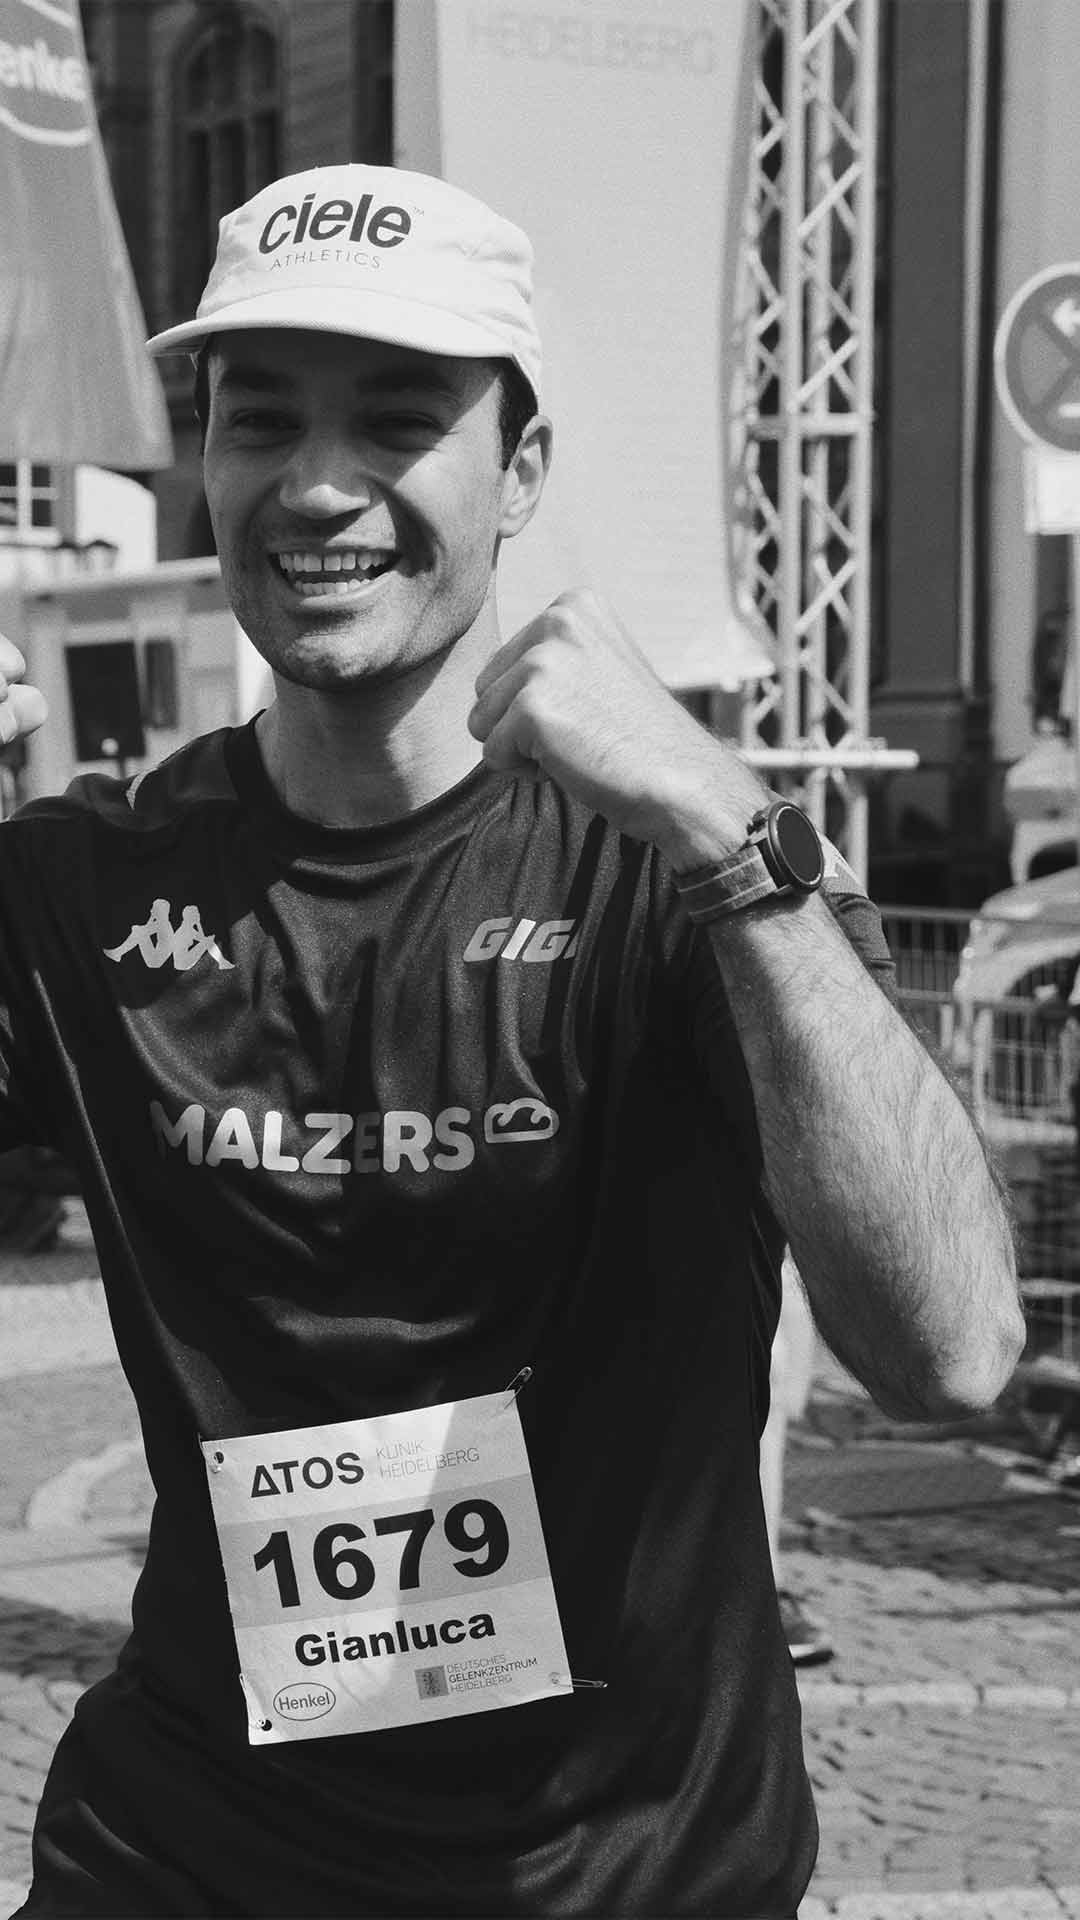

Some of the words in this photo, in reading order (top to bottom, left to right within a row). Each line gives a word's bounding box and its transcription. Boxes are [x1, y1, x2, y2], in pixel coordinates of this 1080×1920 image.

[259, 193, 412, 254] ciele
[270, 250, 380, 271] ATHLETICS
[150, 1101, 475, 1174] MALZERS
[376, 1440, 424, 1460] KLINIK
[379, 1447, 480, 1478] HEIDELBERG
[253, 1499, 510, 1609] 1679
[294, 1613, 496, 1667] Gianluca
[446, 1655, 506, 1674] DEUTSCHES
[448, 1657, 538, 1683] GELENKZENTRUM
[450, 1674, 513, 1694] HEIDELBERG
[278, 1692, 331, 1711] Henkel
